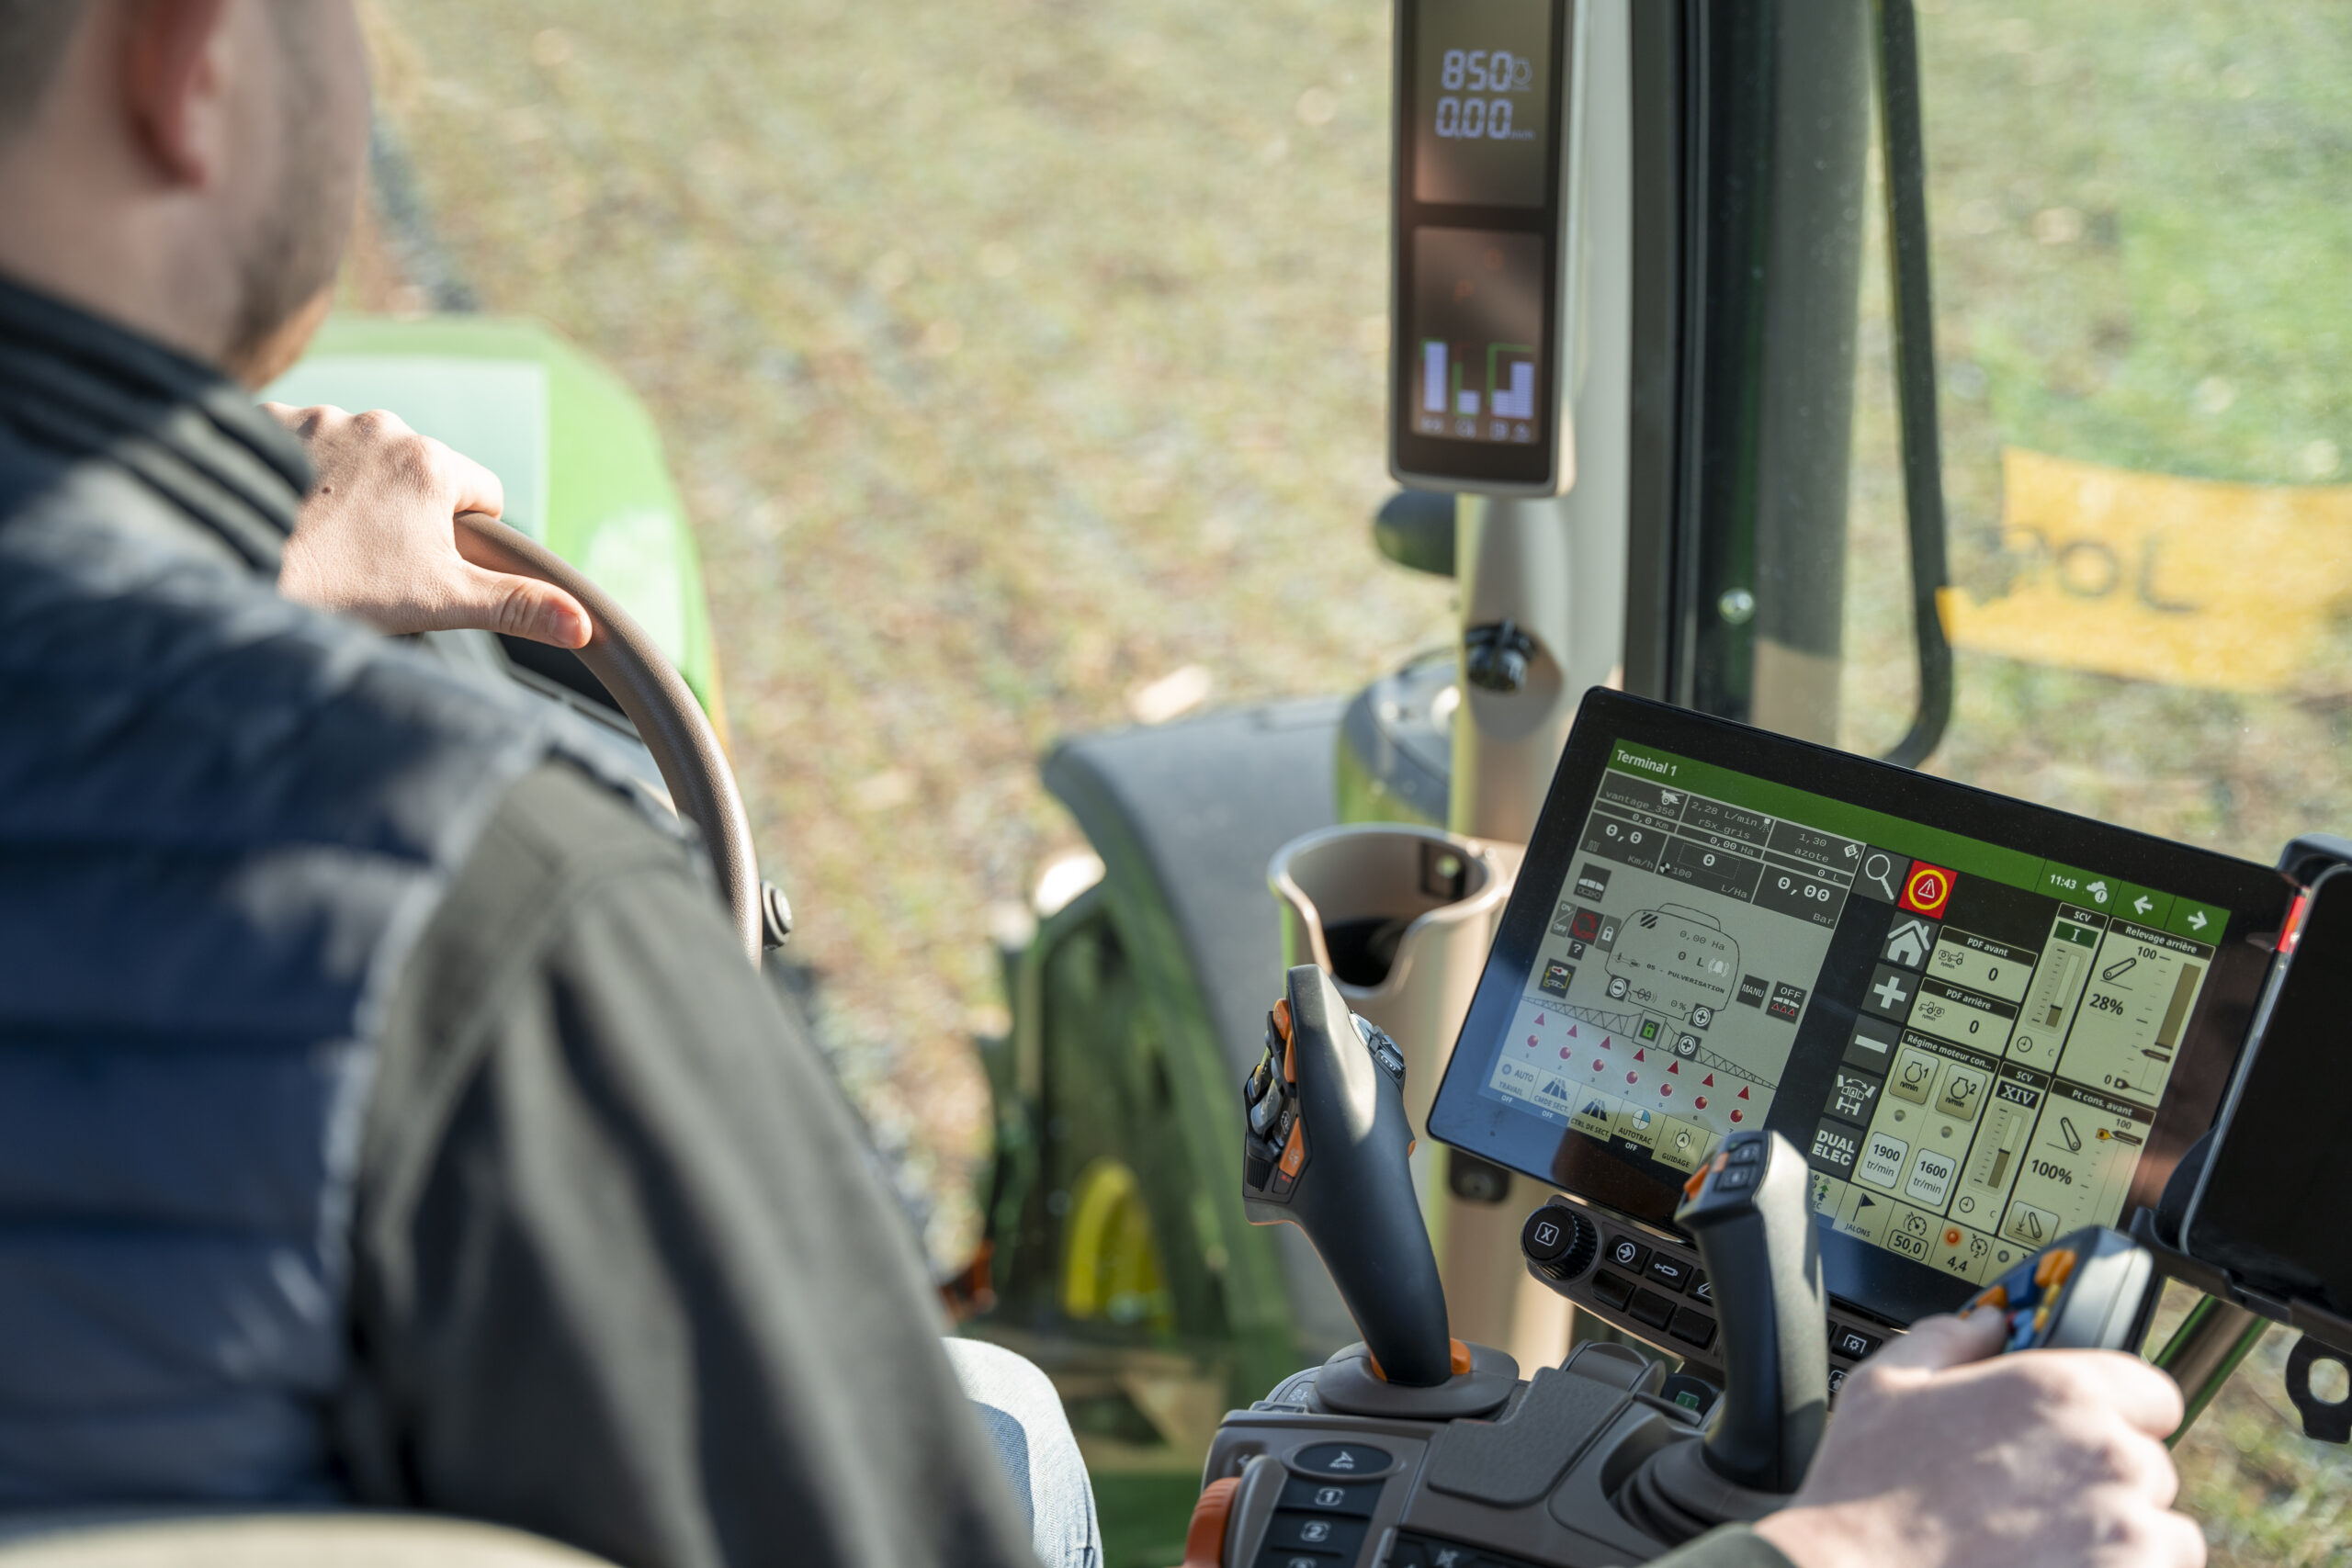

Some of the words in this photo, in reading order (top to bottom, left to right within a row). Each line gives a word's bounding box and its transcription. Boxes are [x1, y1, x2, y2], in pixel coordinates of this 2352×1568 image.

[1441, 49, 1513, 91] 850
[1616, 750, 1669, 774] Terminal
[1671, 765, 1678, 777] 1
[1605, 791, 1676, 817] vantage_350
[1632, 813, 1652, 825] 0,0
[1655, 821, 1669, 830] Km
[1691, 801, 1718, 815] 2,28
[1724, 811, 1758, 827] L/min
[1606, 824, 1643, 844] 0,0
[1798, 833, 1827, 847] 1,30
[1710, 837, 1737, 851] 0,00
[1740, 846, 1754, 856] Ha
[1794, 846, 1829, 863] azote
[1628, 855, 1654, 869] Km/h
[1703, 854, 1716, 867] 0
[1673, 867, 1692, 879] 100
[1778, 876, 1830, 902] 0,00
[2050, 874, 2077, 890] 11:43
[1721, 884, 1748, 898] L/Ha
[1813, 913, 1835, 925] Bar
[2073, 911, 2092, 922] SCV
[1679, 930, 1706, 944] 0,00
[1712, 940, 1725, 951] Ha
[1967, 938, 1983, 950] PDF
[1984, 944, 2009, 957] avant
[2126, 926, 2165, 945] Relevage
[2165, 938, 2197, 954] arrière
[1678, 951, 1686, 961] 0
[1697, 957, 1704, 967] L
[2137, 946, 2157, 960] 100
[1668, 970, 1725, 994] PULVERISATION
[1988, 967, 1999, 981] 0
[1741, 984, 1765, 998] MANU
[1780, 987, 1802, 999] OFF
[1671, 999, 1687, 1010] 0%
[1946, 989, 1962, 1000] PDF
[1963, 995, 1992, 1010] arrière
[2089, 993, 2125, 1016] 28%
[1969, 1020, 1979, 1034] 0
[1907, 1034, 1938, 1051] Régime
[1939, 1045, 1970, 1062] moteur
[1514, 1070, 1534, 1083] AUTO
[1923, 1068, 1929, 1079] 1
[2016, 1071, 2034, 1083] SCV
[2104, 1074, 2112, 1085] 0
[1498, 1081, 1523, 1096] TRAVAIL
[1968, 1083, 1977, 1095] 2
[2001, 1085, 2035, 1105] XIV
[1534, 1095, 1553, 1108] CMDE
[2072, 1089, 2082, 1099] Pt
[2083, 1094, 2105, 1107] cons.
[2106, 1103, 2133, 1117] avant
[1542, 1110, 1554, 1119] OFF
[1570, 1117, 1585, 1128] CTRL
[1586, 1122, 1594, 1131] DE
[2115, 1118, 2132, 1130] 100
[1618, 1127, 1653, 1145] AUTOTRAC
[1816, 1129, 1855, 1154] DUAL
[1625, 1142, 1638, 1151] OFF
[1811, 1142, 1852, 1167] ELEC
[1873, 1143, 1900, 1162] 1900
[1661, 1153, 1691, 1168] GUIDAGE
[1866, 1160, 1894, 1177] tr/min
[1920, 1160, 1948, 1179] 1600
[2031, 1159, 2072, 1185] 100%
[1913, 1176, 1941, 1194] tr/min
[1541, 1227, 1553, 1241] X
[1844, 1223, 1871, 1237] JALONS
[1894, 1235, 1922, 1255] 50,0
[1947, 1256, 1968, 1272] 4,4
[1324, 1491, 1334, 1503] 1
[1311, 1526, 1323, 1538] 2
